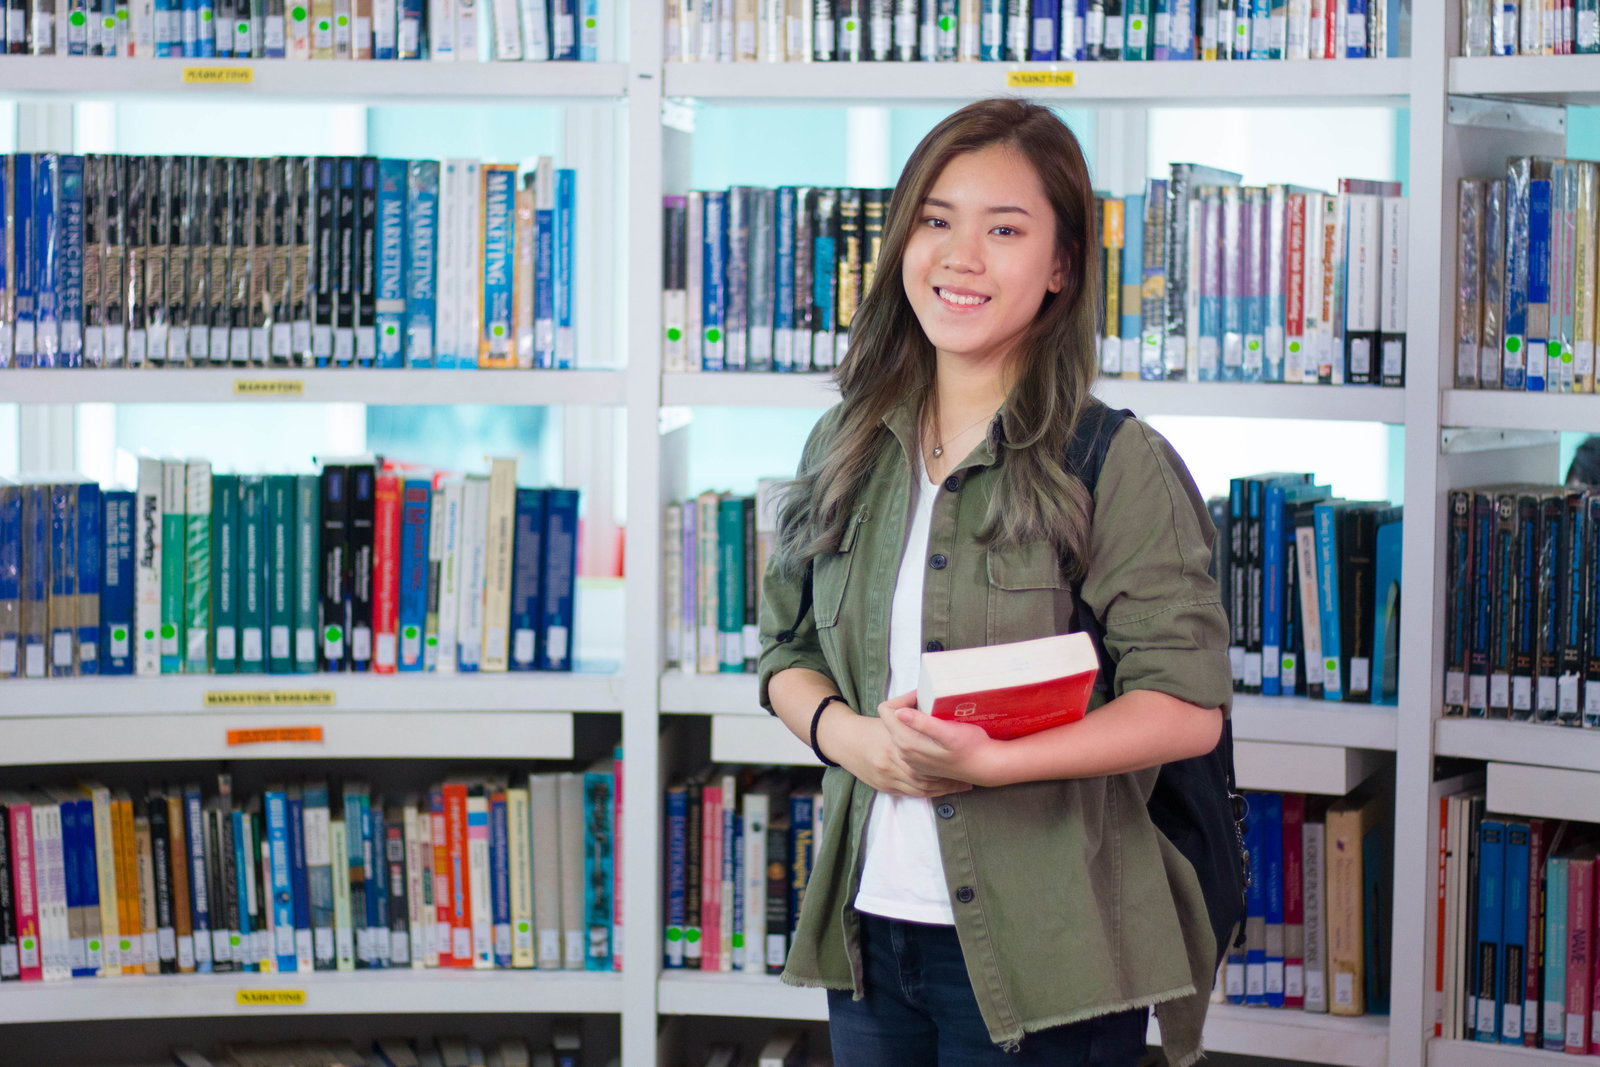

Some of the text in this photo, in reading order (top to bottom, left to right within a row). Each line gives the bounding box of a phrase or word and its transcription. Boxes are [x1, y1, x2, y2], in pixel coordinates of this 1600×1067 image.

[66, 201, 81, 308] PRINCIPLES
[382, 199, 402, 298] MARKETING
[412, 200, 433, 299] MARKETING
[487, 174, 508, 285] MARKETING
